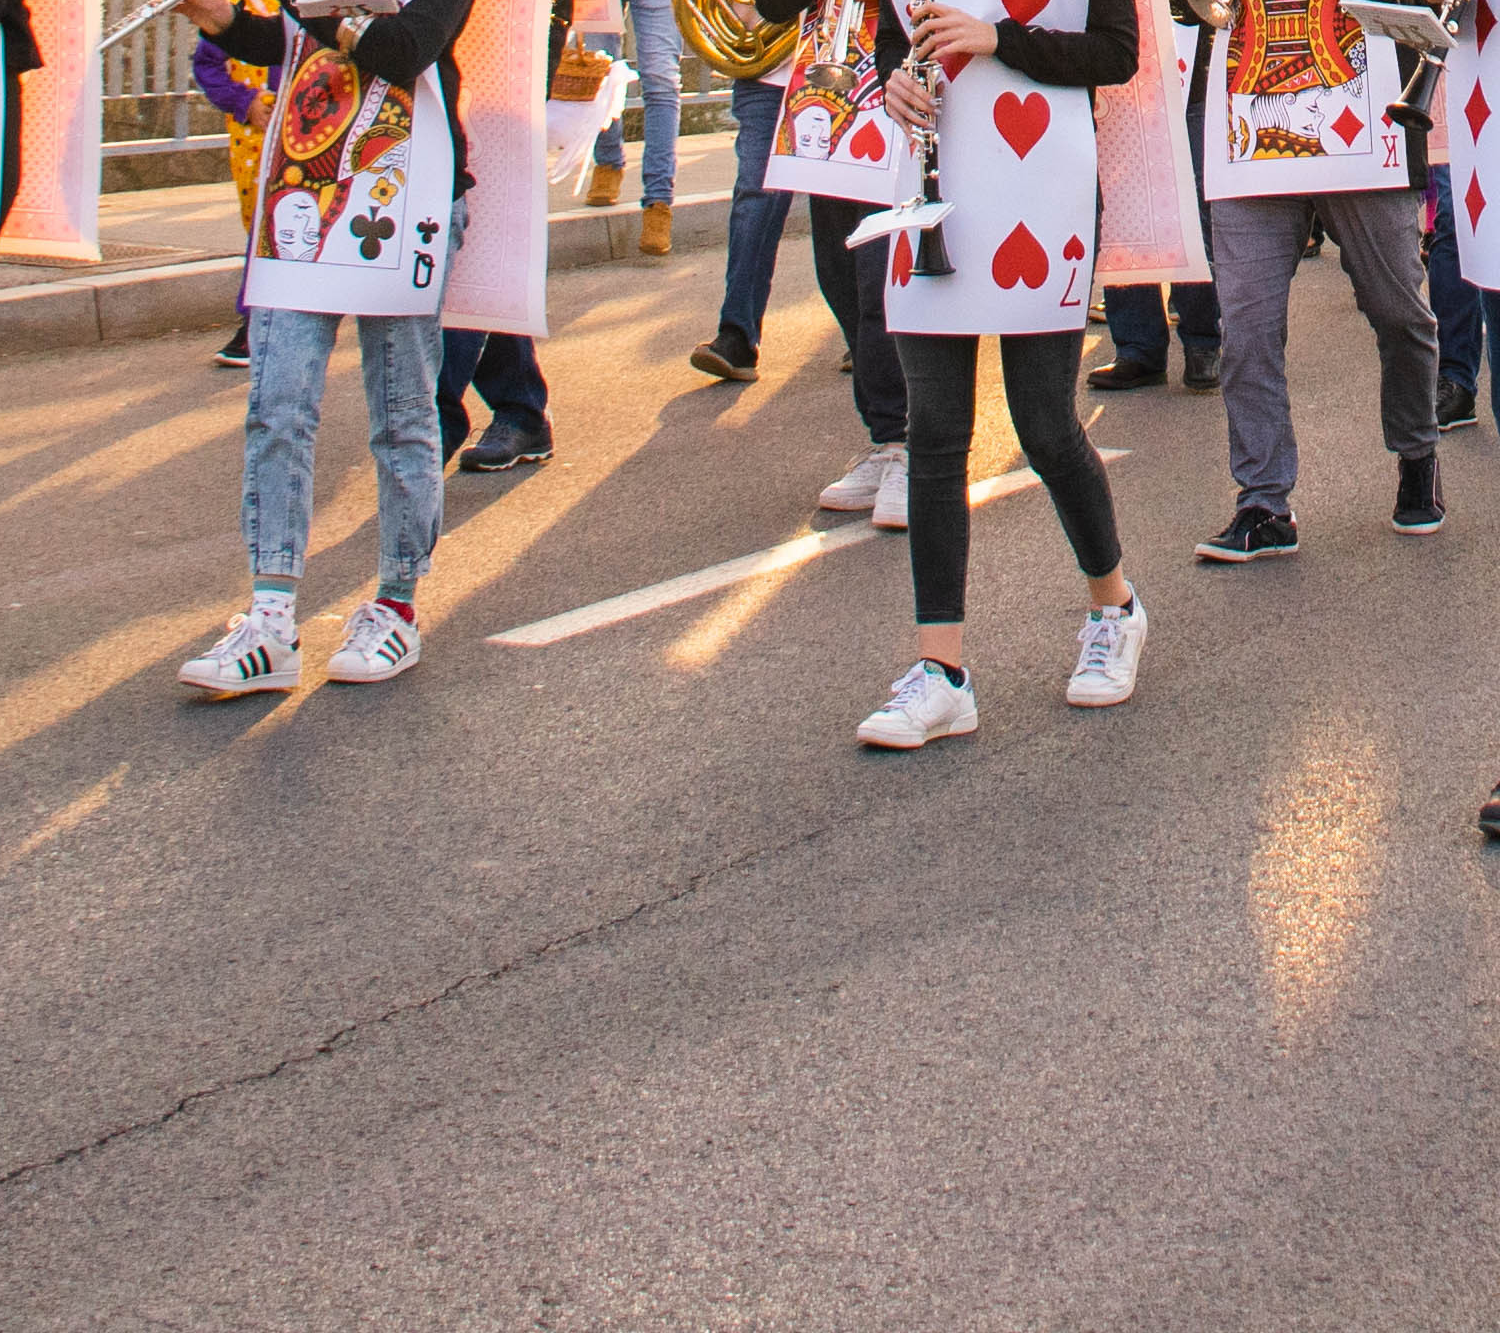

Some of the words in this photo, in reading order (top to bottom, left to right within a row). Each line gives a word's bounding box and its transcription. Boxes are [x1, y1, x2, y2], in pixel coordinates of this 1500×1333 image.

[1381, 135, 1400, 168] K
[413, 249, 436, 289] Q
[1060, 267, 1081, 308] 7
